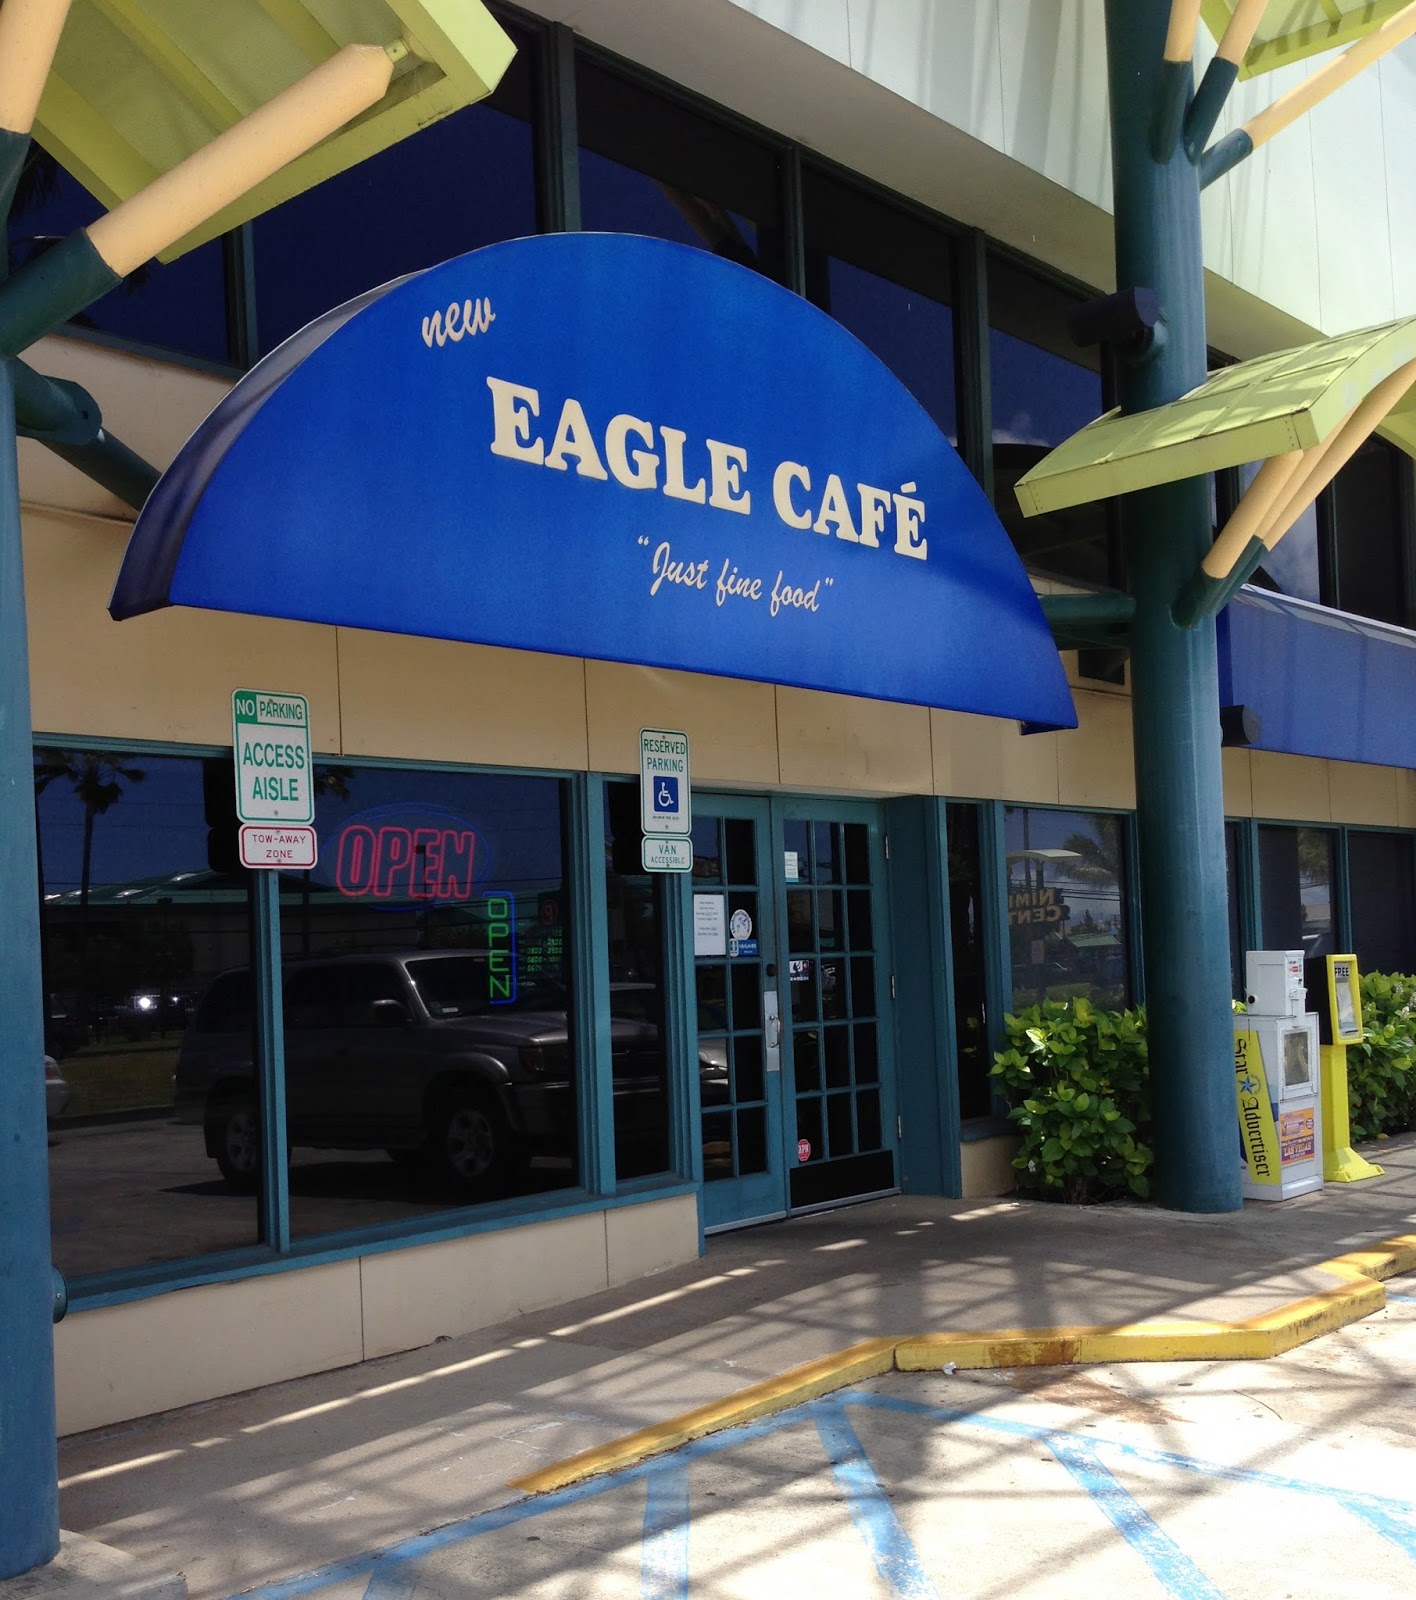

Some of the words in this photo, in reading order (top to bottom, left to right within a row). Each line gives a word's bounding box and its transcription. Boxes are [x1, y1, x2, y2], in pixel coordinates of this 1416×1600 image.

[422, 297, 496, 348] new
[487, 375, 751, 515] EAGLE
[773, 460, 928, 560] CAFÉ
[716, 558, 762, 605] fine
[237, 698, 255, 717] NO
[260, 700, 303, 720] PARKING
[243, 742, 305, 769] ACCESS
[643, 738, 686, 755] RESERVED
[647, 757, 683, 773] PARKING
[252, 776, 299, 801] AISLE
[252, 834, 306, 844] TOW-AWAY
[658, 845, 677, 855] VAN
[266, 849, 293, 858] ZONE
[336, 825, 475, 899] OPEN
[651, 856, 685, 864] ACCESSIBLE
[487, 898, 510, 998] OPEN
[1334, 966, 1349, 977] FREE
[1242, 1096, 1270, 1177] Advertiser
